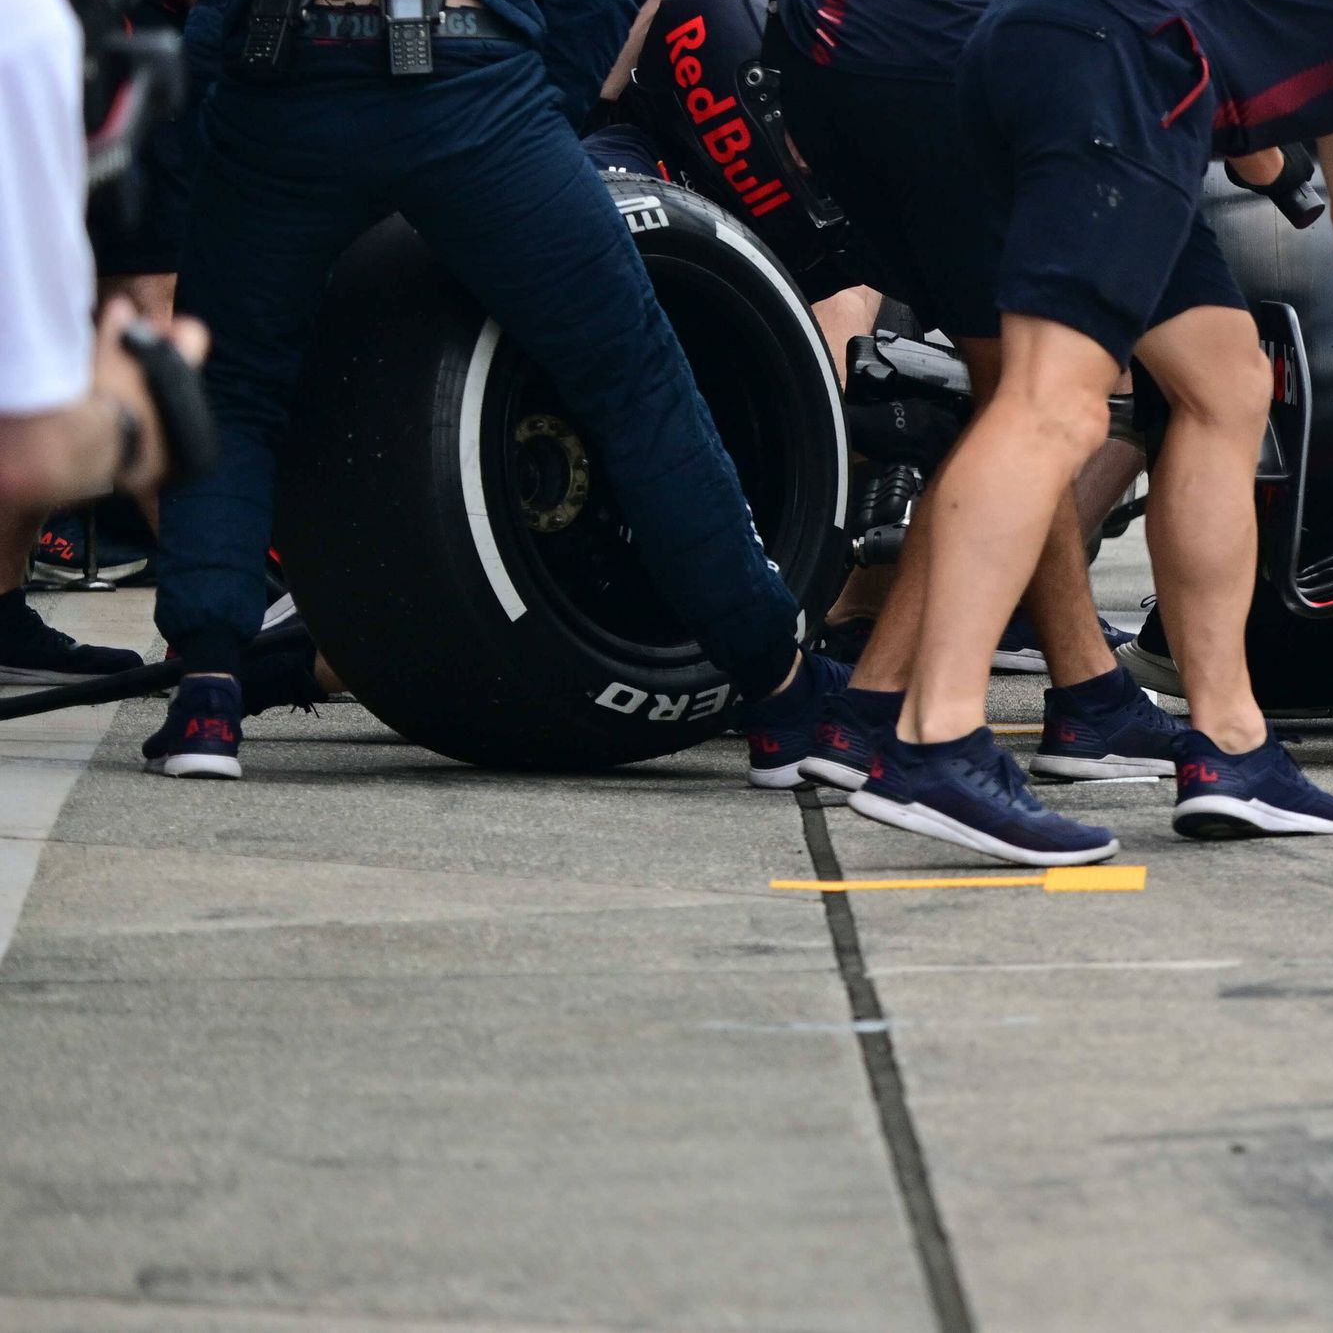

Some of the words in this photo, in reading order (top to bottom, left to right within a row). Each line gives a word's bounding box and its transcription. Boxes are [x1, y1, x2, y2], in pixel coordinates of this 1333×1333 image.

[664, 15, 736, 125] Red
[702, 117, 792, 217] Bull
[594, 681, 743, 721] ERO
